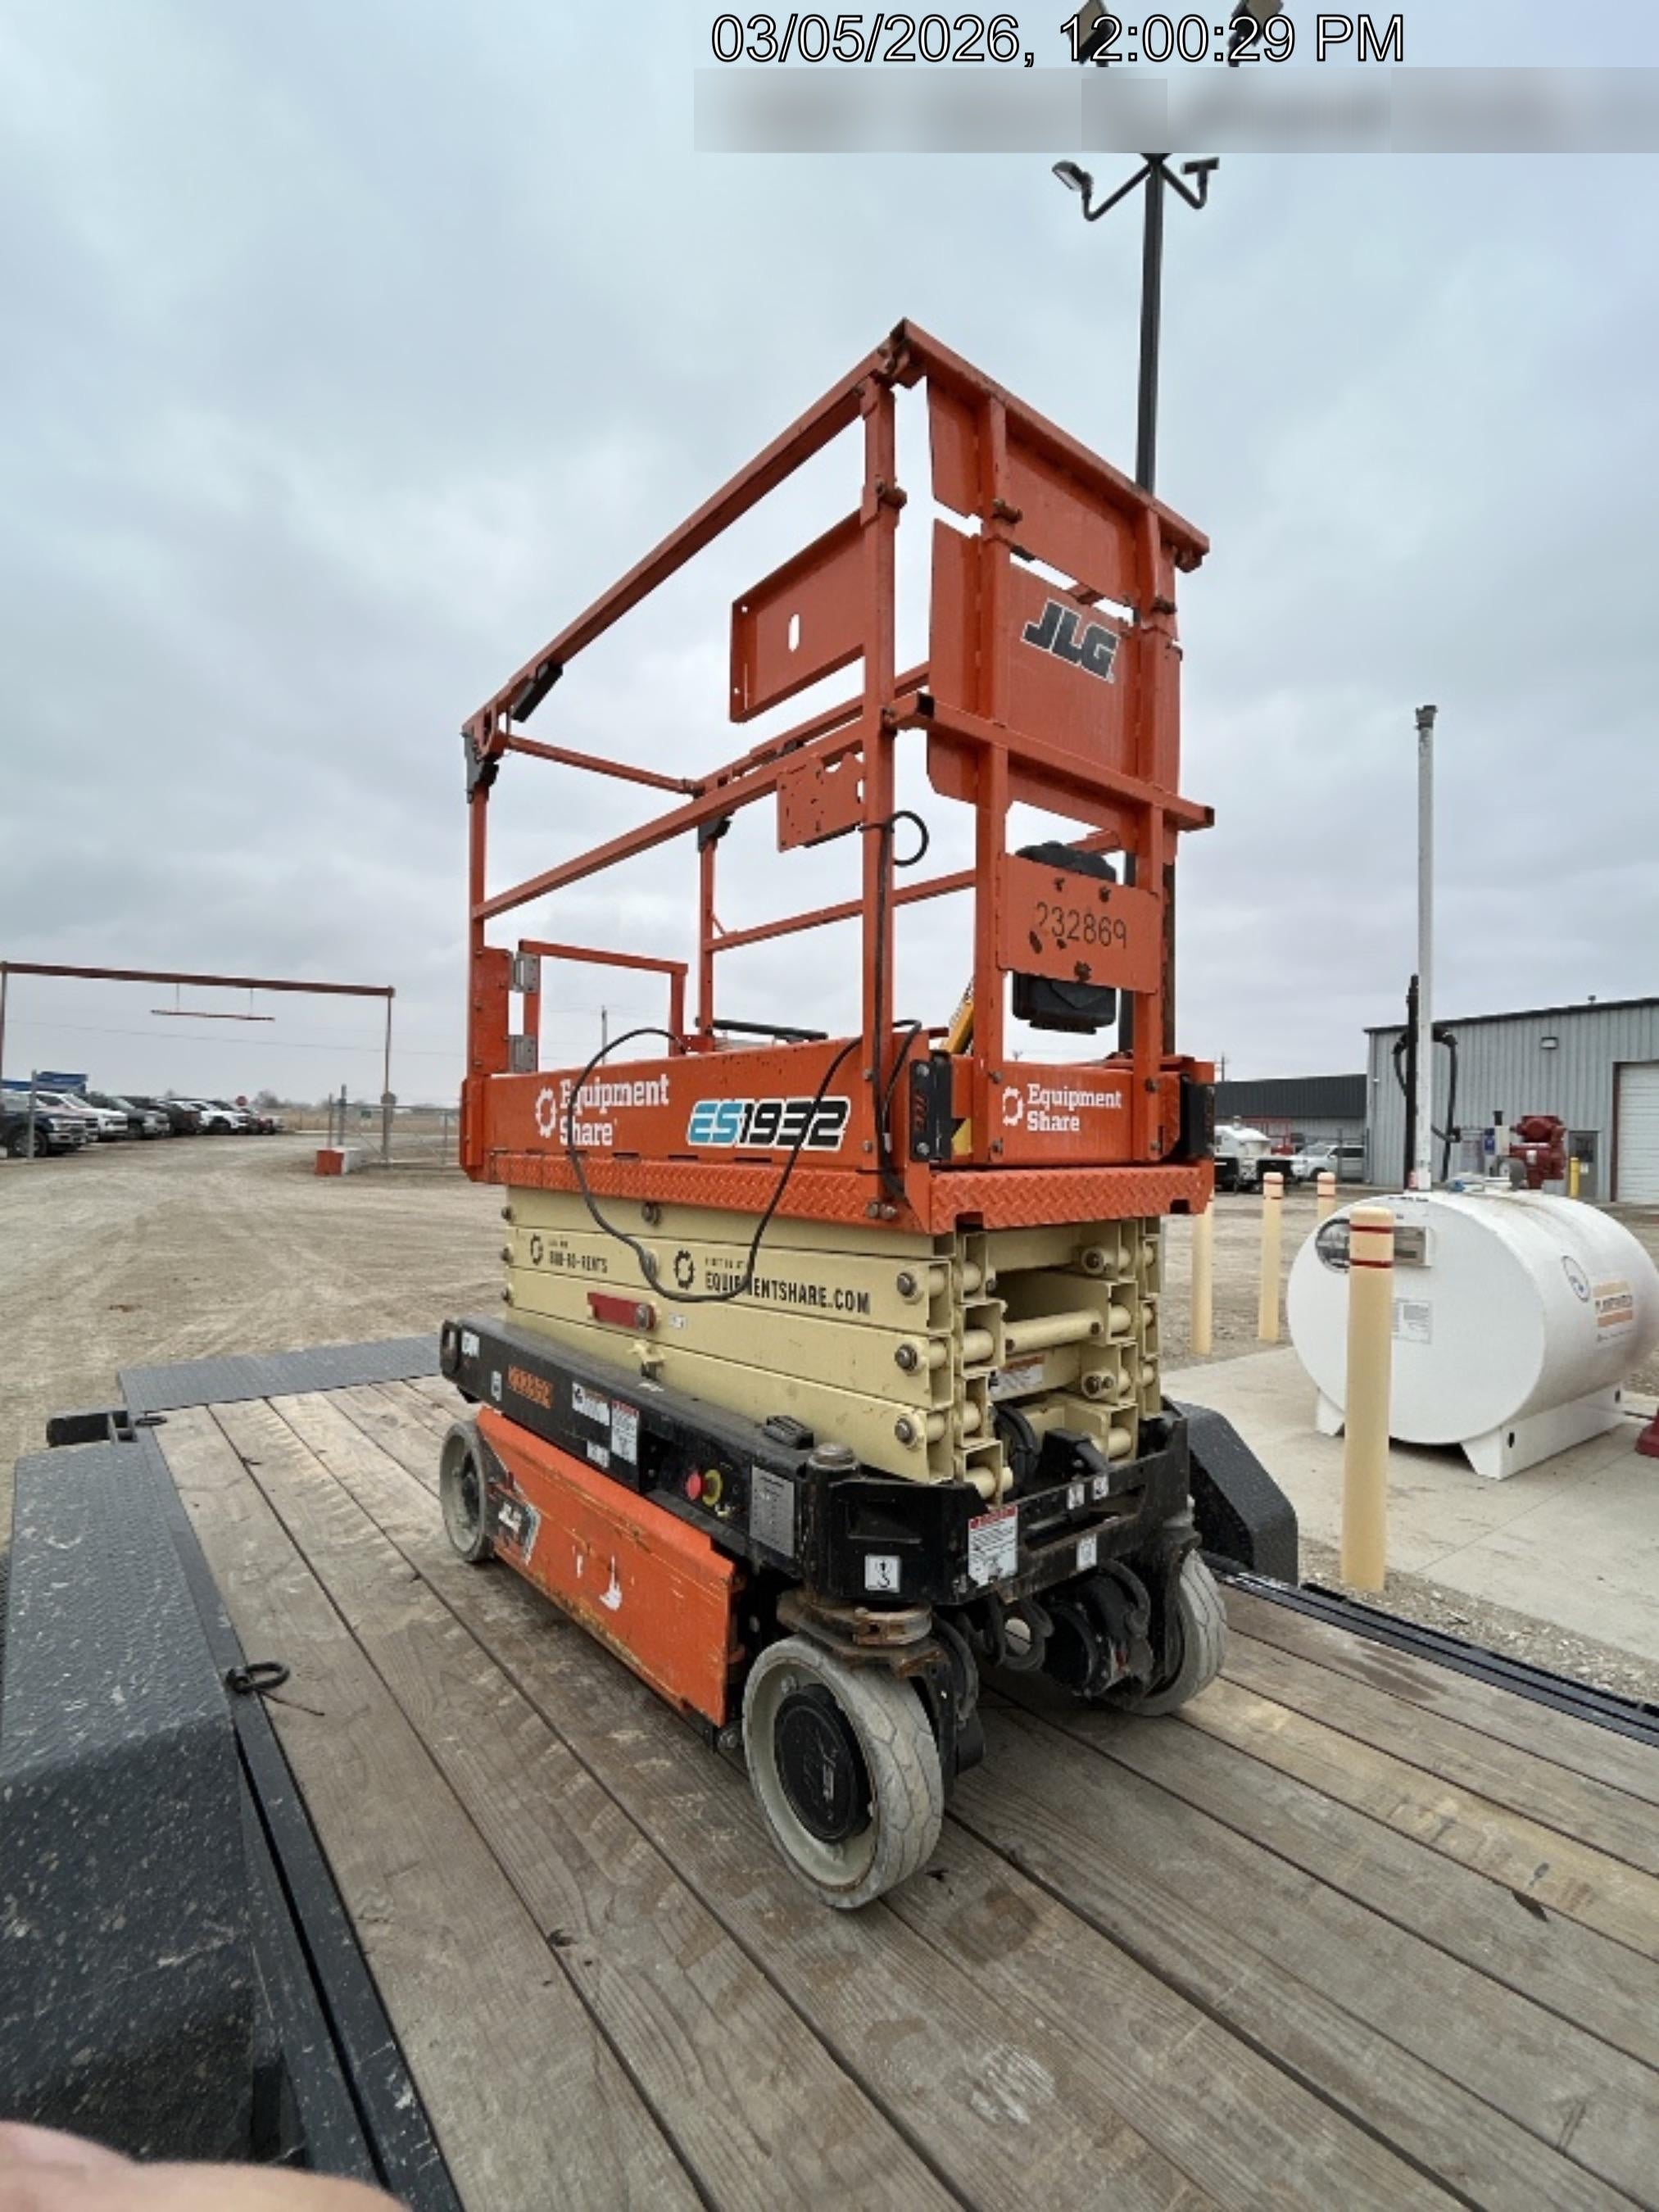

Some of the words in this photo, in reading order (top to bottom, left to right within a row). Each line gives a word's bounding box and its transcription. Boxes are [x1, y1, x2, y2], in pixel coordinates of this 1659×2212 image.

[1022, 598, 1120, 683] JLG
[1036, 901, 1127, 950] 232869
[560, 1073, 670, 1116] Equipment
[1027, 1082, 1122, 1112] Equipment
[560, 1114, 614, 1146] Share
[687, 1096, 850, 1150] ES1932
[1027, 1110, 1081, 1131] Share
